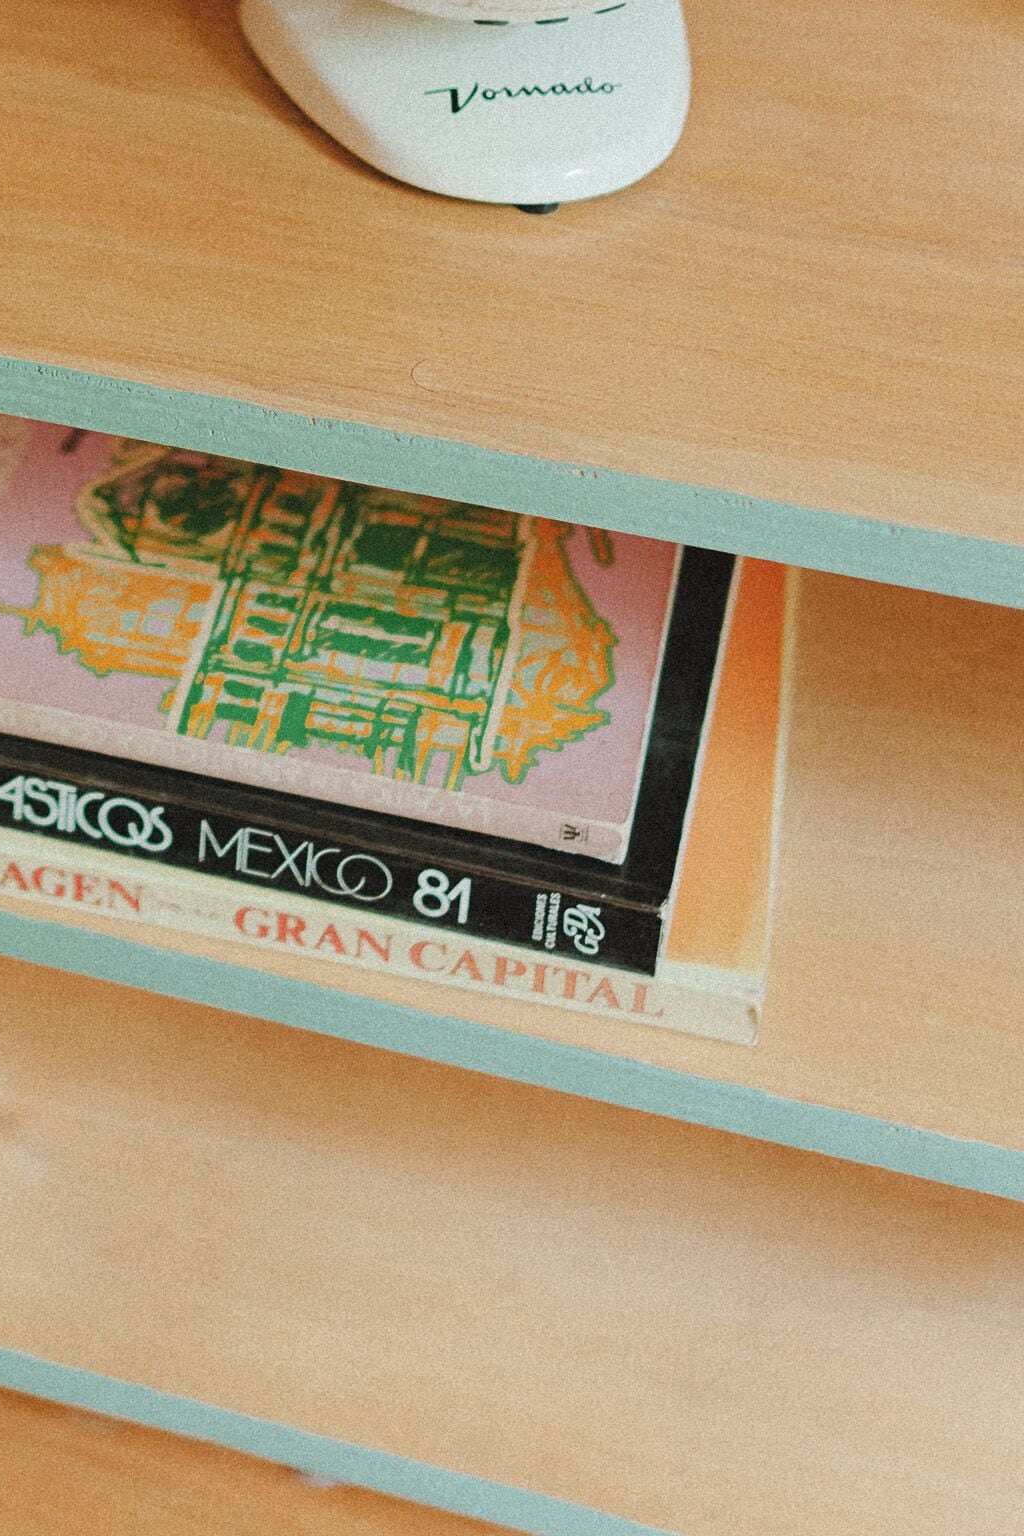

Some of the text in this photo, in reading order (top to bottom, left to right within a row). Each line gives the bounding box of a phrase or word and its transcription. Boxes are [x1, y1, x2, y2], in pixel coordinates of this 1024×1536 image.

[424, 77, 622, 113] Vornado
[198, 819, 393, 901] MEXICO
[412, 868, 472, 924] 81
[532, 893, 547, 941] EDICIONES
[544, 892, 561, 949] CULTURALES
[233, 905, 393, 963] GRAN
[409, 939, 665, 1018] CAPITAL
